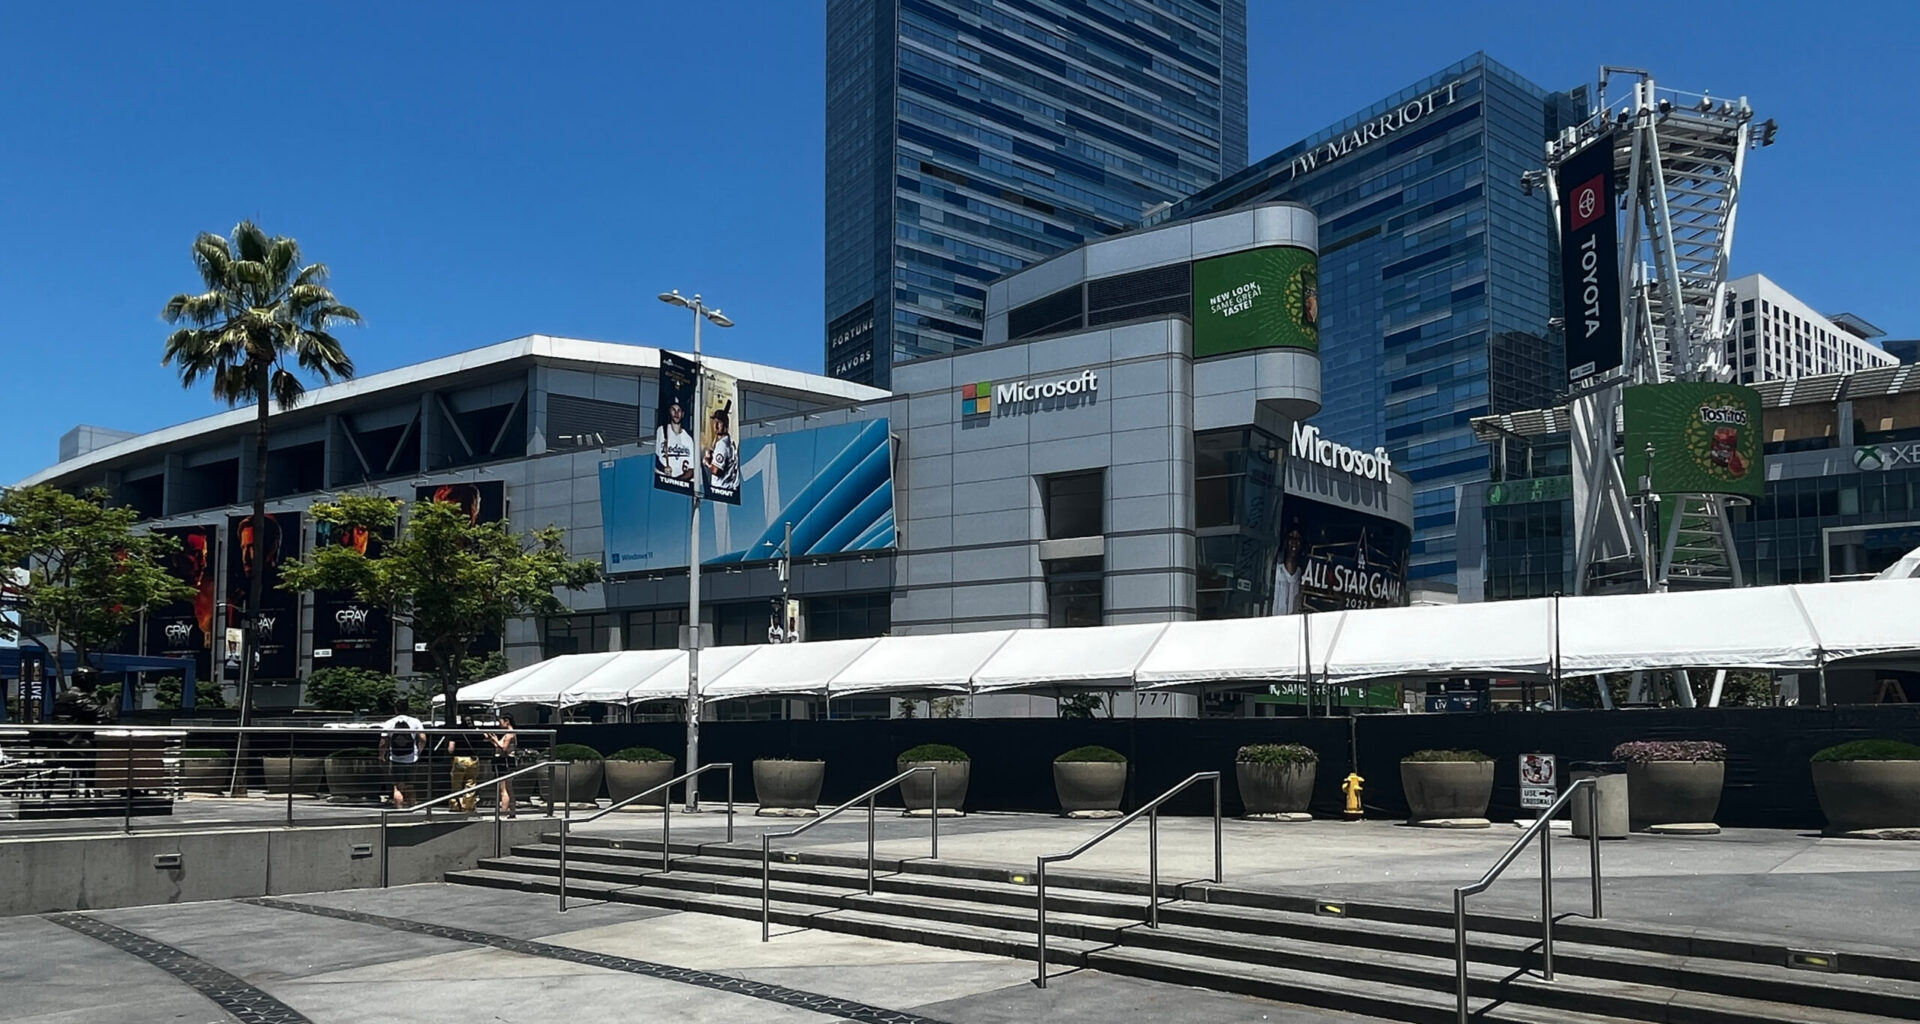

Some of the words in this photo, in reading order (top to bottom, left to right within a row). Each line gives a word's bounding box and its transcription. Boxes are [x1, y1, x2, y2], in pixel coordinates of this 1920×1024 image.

[1290, 147, 1321, 180] JW
[1327, 79, 1462, 162] MARRIOTT
[1581, 233, 1601, 338] TOYOTA
[1209, 291, 1230, 305] NEW
[1210, 298, 1234, 314] SAME
[1223, 299, 1253, 317] TASTE!
[832, 318, 874, 348] FORTUNE
[836, 350, 871, 375] FAVORS
[997, 369, 1098, 405] Microsoft
[1291, 420, 1392, 484] Microsoft
[659, 477, 690, 488] TURNER
[711, 487, 733, 497] TROUT
[1301, 559, 1329, 590] ALL
[1333, 565, 1368, 597] STAR
[1345, 597, 1368, 609] 2022
[335, 609, 368, 623] GRAY
[165, 624, 193, 638] GRAY
[30, 681, 42, 700] LIVE
[1138, 692, 1169, 706] 777
